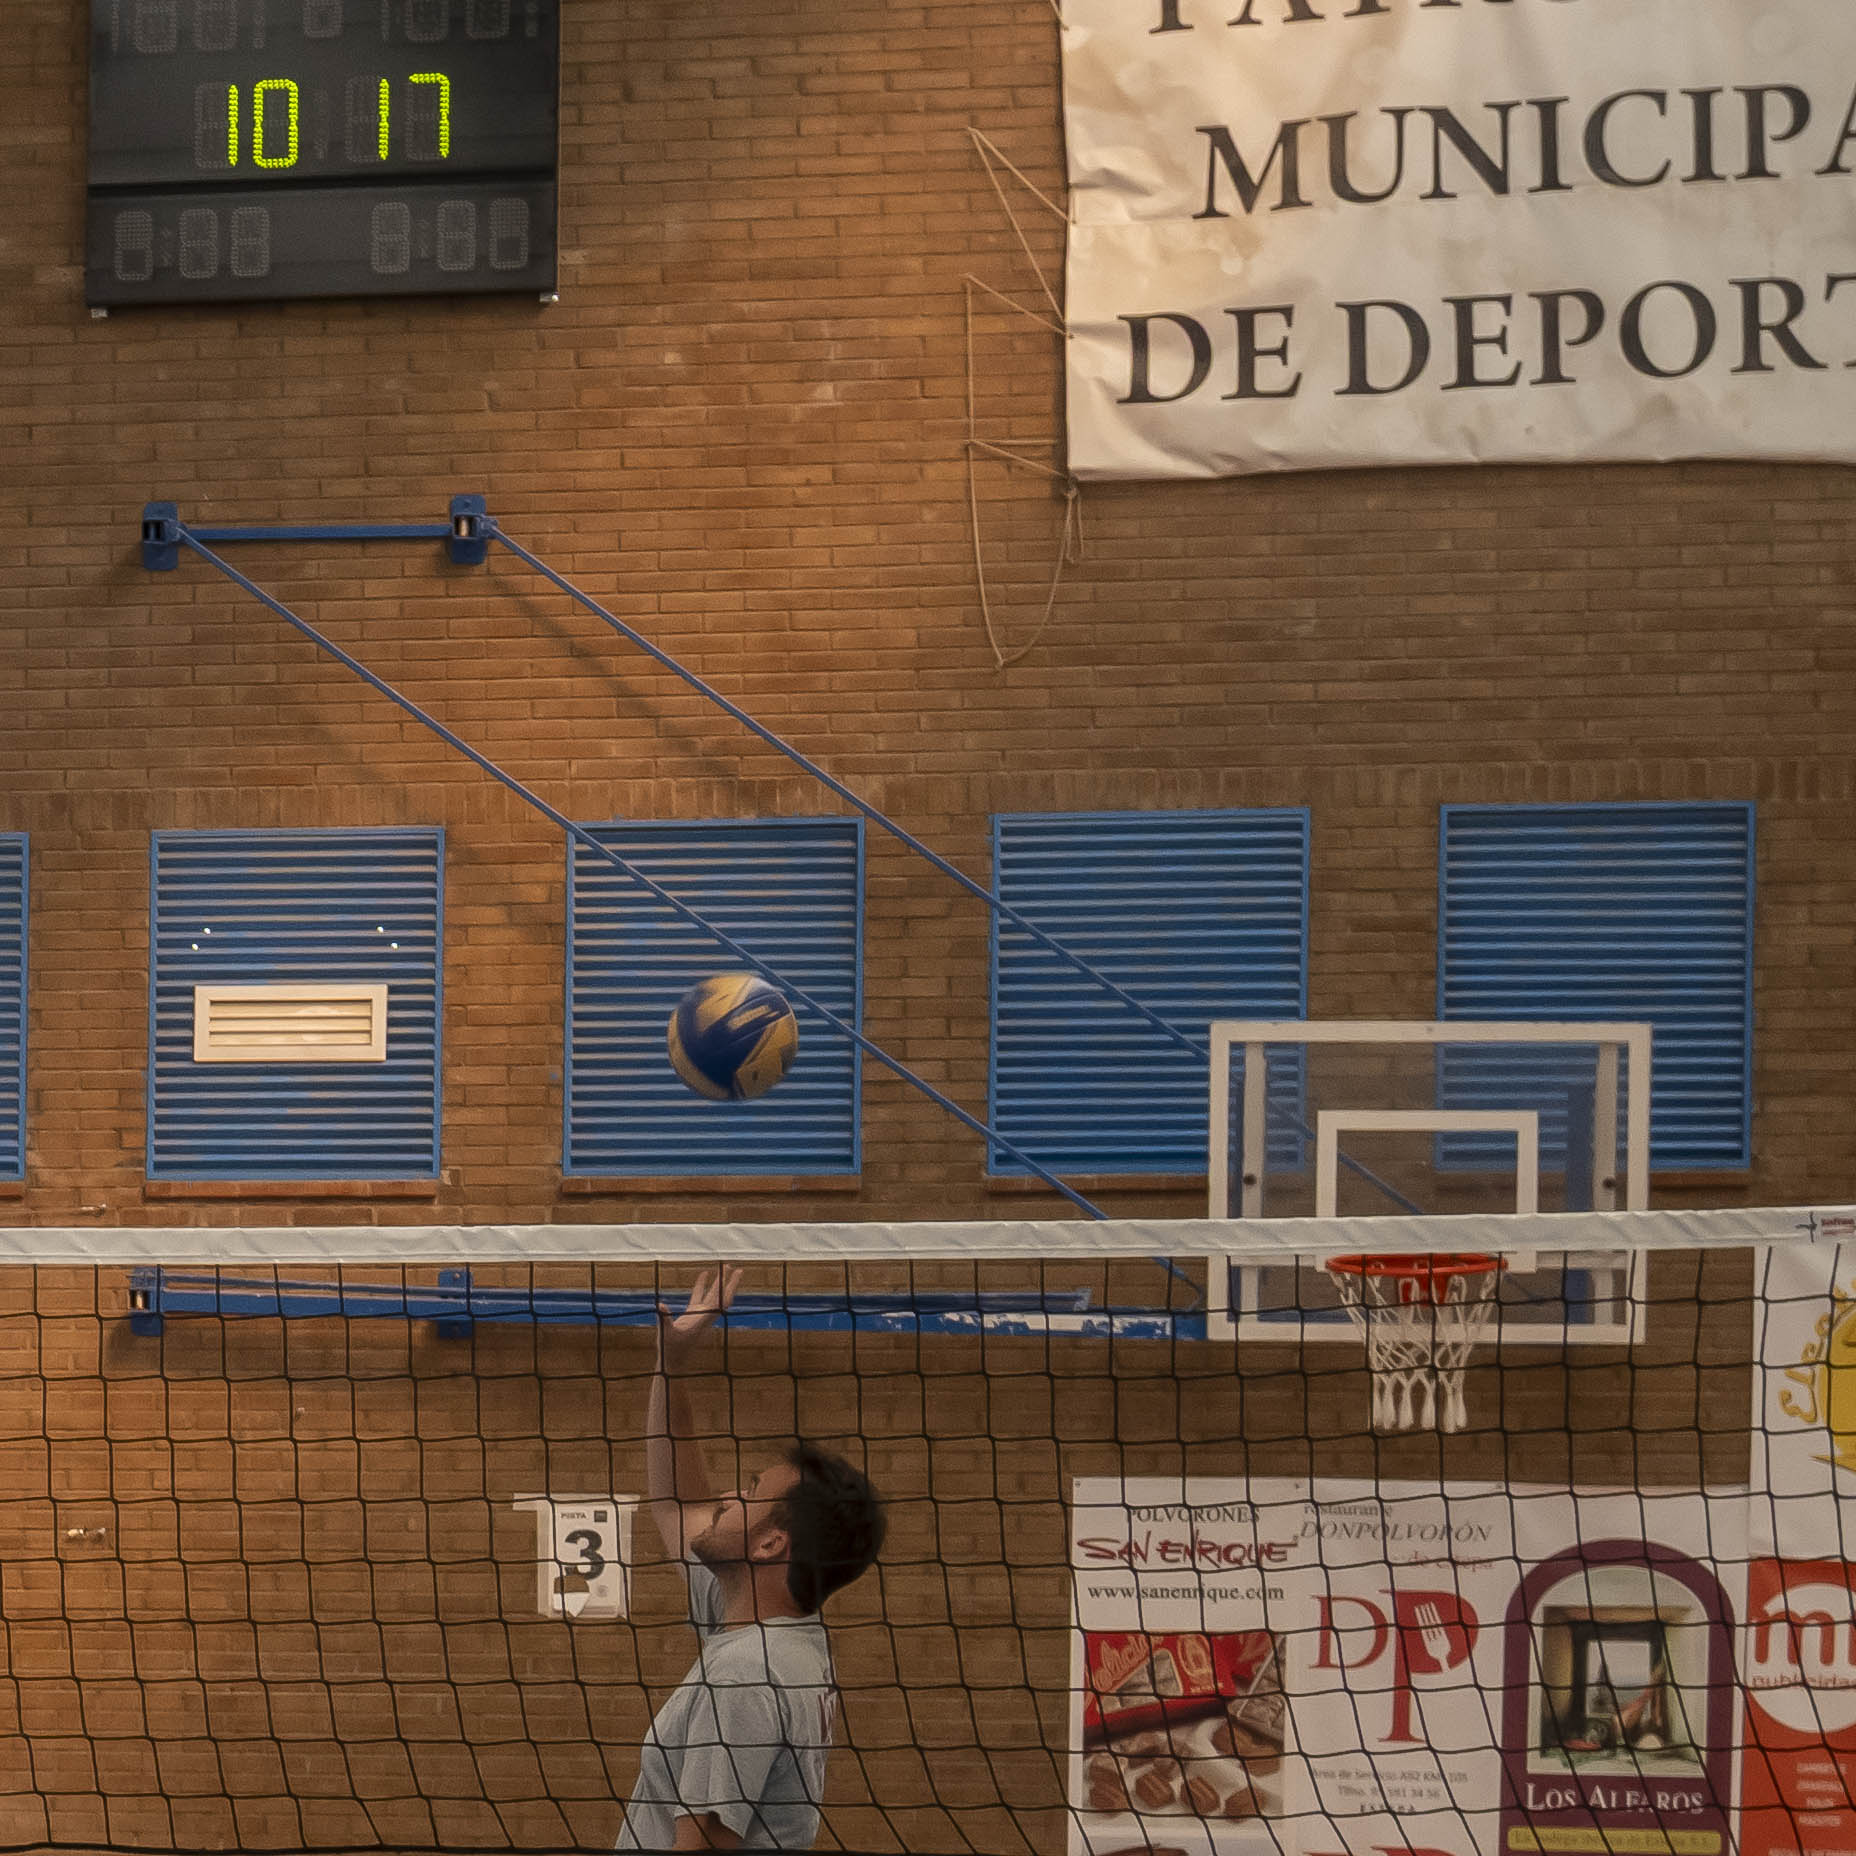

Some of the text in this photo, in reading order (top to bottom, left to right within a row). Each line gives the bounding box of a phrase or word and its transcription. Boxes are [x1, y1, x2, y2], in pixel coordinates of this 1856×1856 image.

[228, 72, 450, 169] 10 17
[1117, 303, 1303, 405] DE
[565, 1529, 605, 1580] 3
[1077, 1529, 1298, 1568] SAN ENRIQUE
